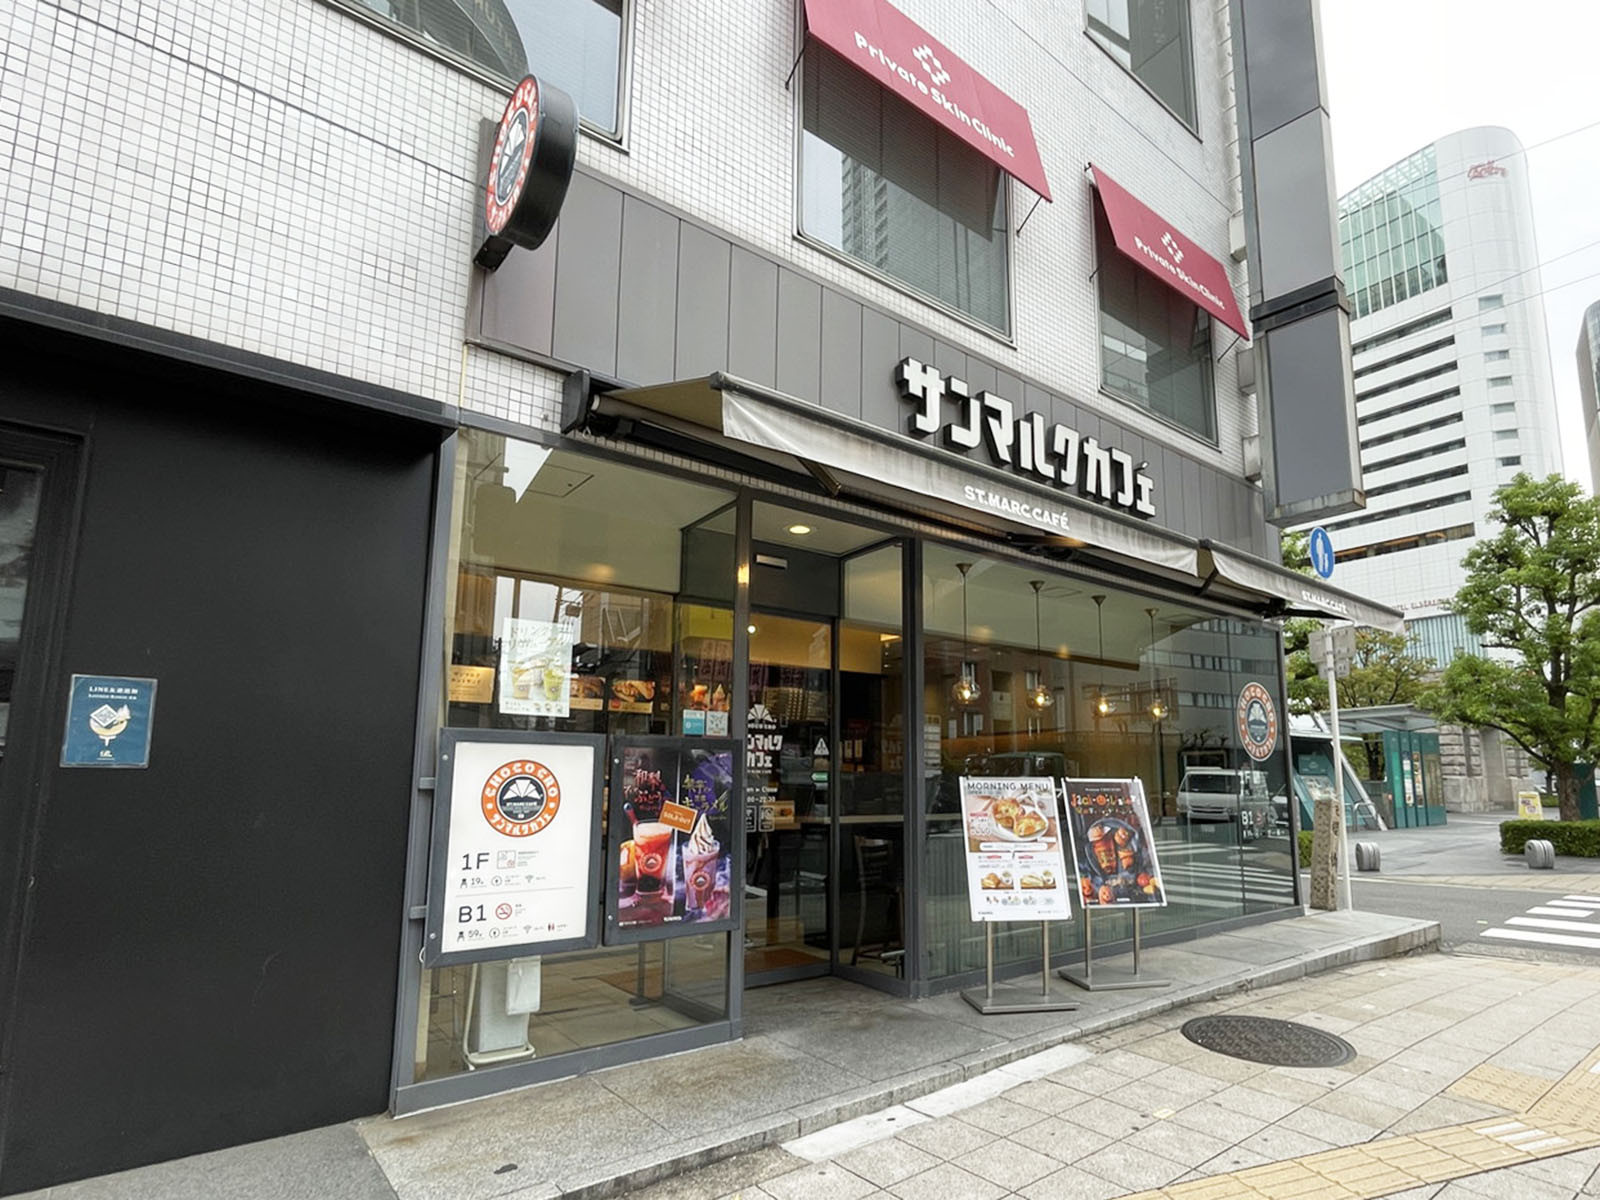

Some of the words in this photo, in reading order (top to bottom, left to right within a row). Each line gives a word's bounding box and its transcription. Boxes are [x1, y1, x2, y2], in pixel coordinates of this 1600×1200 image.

[854, 31, 929, 96] Private
[930, 87, 972, 127] Skin
[971, 117, 1015, 158] Clinic
[1134, 235, 1177, 275] Private
[1176, 267, 1201, 292] Skin
[1199, 284, 1225, 310] Clinic
[900, 356, 1156, 517] サンマルクカフェ
[964, 485, 1033, 519] ST.MARC
[1031, 509, 1070, 531] CAFÉ
[484, 762, 536, 798] CHOCO
[536, 767, 559, 798] CRO
[967, 782, 1017, 791] MORNING
[1020, 782, 1049, 791] MENU
[461, 852, 490, 871] 1F
[458, 904, 487, 923] B1
